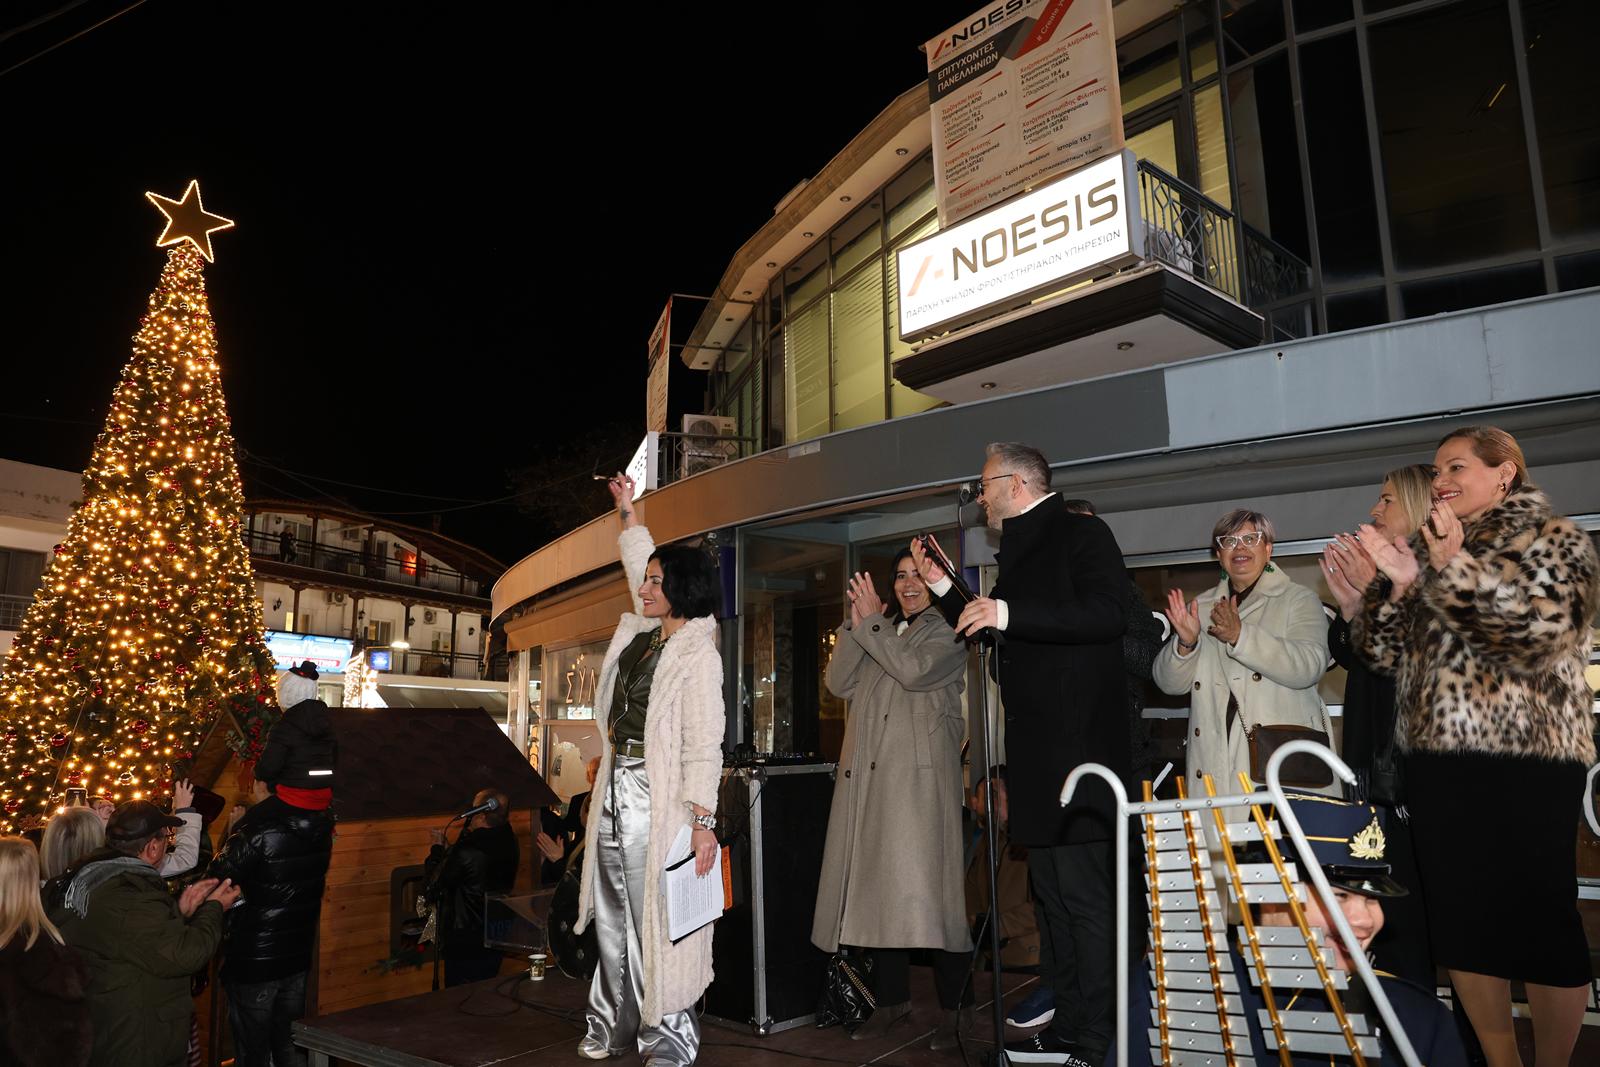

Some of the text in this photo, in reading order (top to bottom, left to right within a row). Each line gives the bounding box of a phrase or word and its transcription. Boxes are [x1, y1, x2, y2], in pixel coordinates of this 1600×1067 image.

[937, 40, 995, 80] ΕΠΙΤΥΧΟΝΤΕΣ
[937, 51, 998, 92] ΠΑΝΕΛΛΗΝΙΩΝ
[952, 178, 1119, 281] NOESIS
[906, 299, 938, 319] ΠΑΡΟΧΗ
[976, 251, 1061, 292] ΦΡΟΝΤΙΣΤΗΡΙΑΚΩΝ
[1063, 228, 1120, 259] ΥΠΗΡΕΣΙΩΝ
